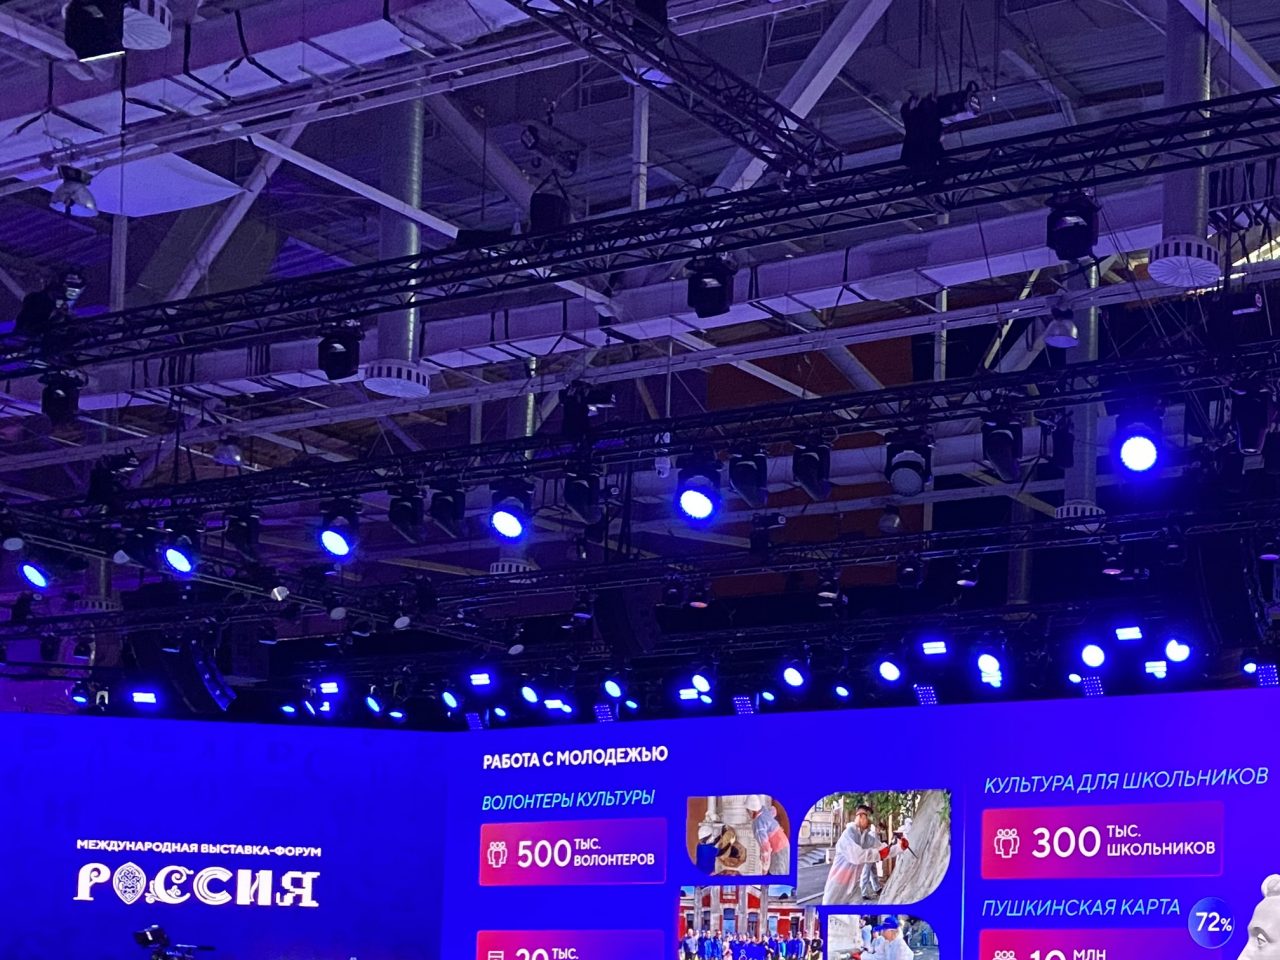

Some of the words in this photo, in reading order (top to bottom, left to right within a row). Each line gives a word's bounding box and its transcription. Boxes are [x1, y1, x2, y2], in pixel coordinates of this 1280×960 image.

[483, 752, 540, 770] РАБОТА
[542, 751, 554, 767] С
[556, 745, 669, 767] МОЛОДЕЖЬЮ
[984, 774, 1075, 794] КУЛЬТУРА
[1077, 773, 1119, 794] ДЛЯ
[1122, 767, 1269, 789] ШКОЛЬНИКОВ
[481, 792, 573, 811] ВОЛОНТЕРЫ
[576, 789, 656, 807] КУЛЬТУРЫ
[1106, 824, 1141, 838] ТЫС.
[76, 839, 198, 854] МЕЖДУНАРОДНАЯ
[201, 843, 322, 857] ВЫСТАВКА-ФОРУМ
[573, 837, 601, 850] ТЫС.
[1031, 825, 1101, 859] 300
[1107, 841, 1216, 857] ШКОЛЬНИКОВ
[517, 839, 572, 868] 500
[573, 853, 655, 867] ВОЛОНТЕРОВ
[73, 861, 321, 908] РОССИЯ
[982, 898, 1116, 917] ПУШКИНСКАЯ
[1120, 898, 1181, 915] КАРТА
[1195, 911, 1233, 932] 72%
[551, 947, 579, 960] ТЫС.
